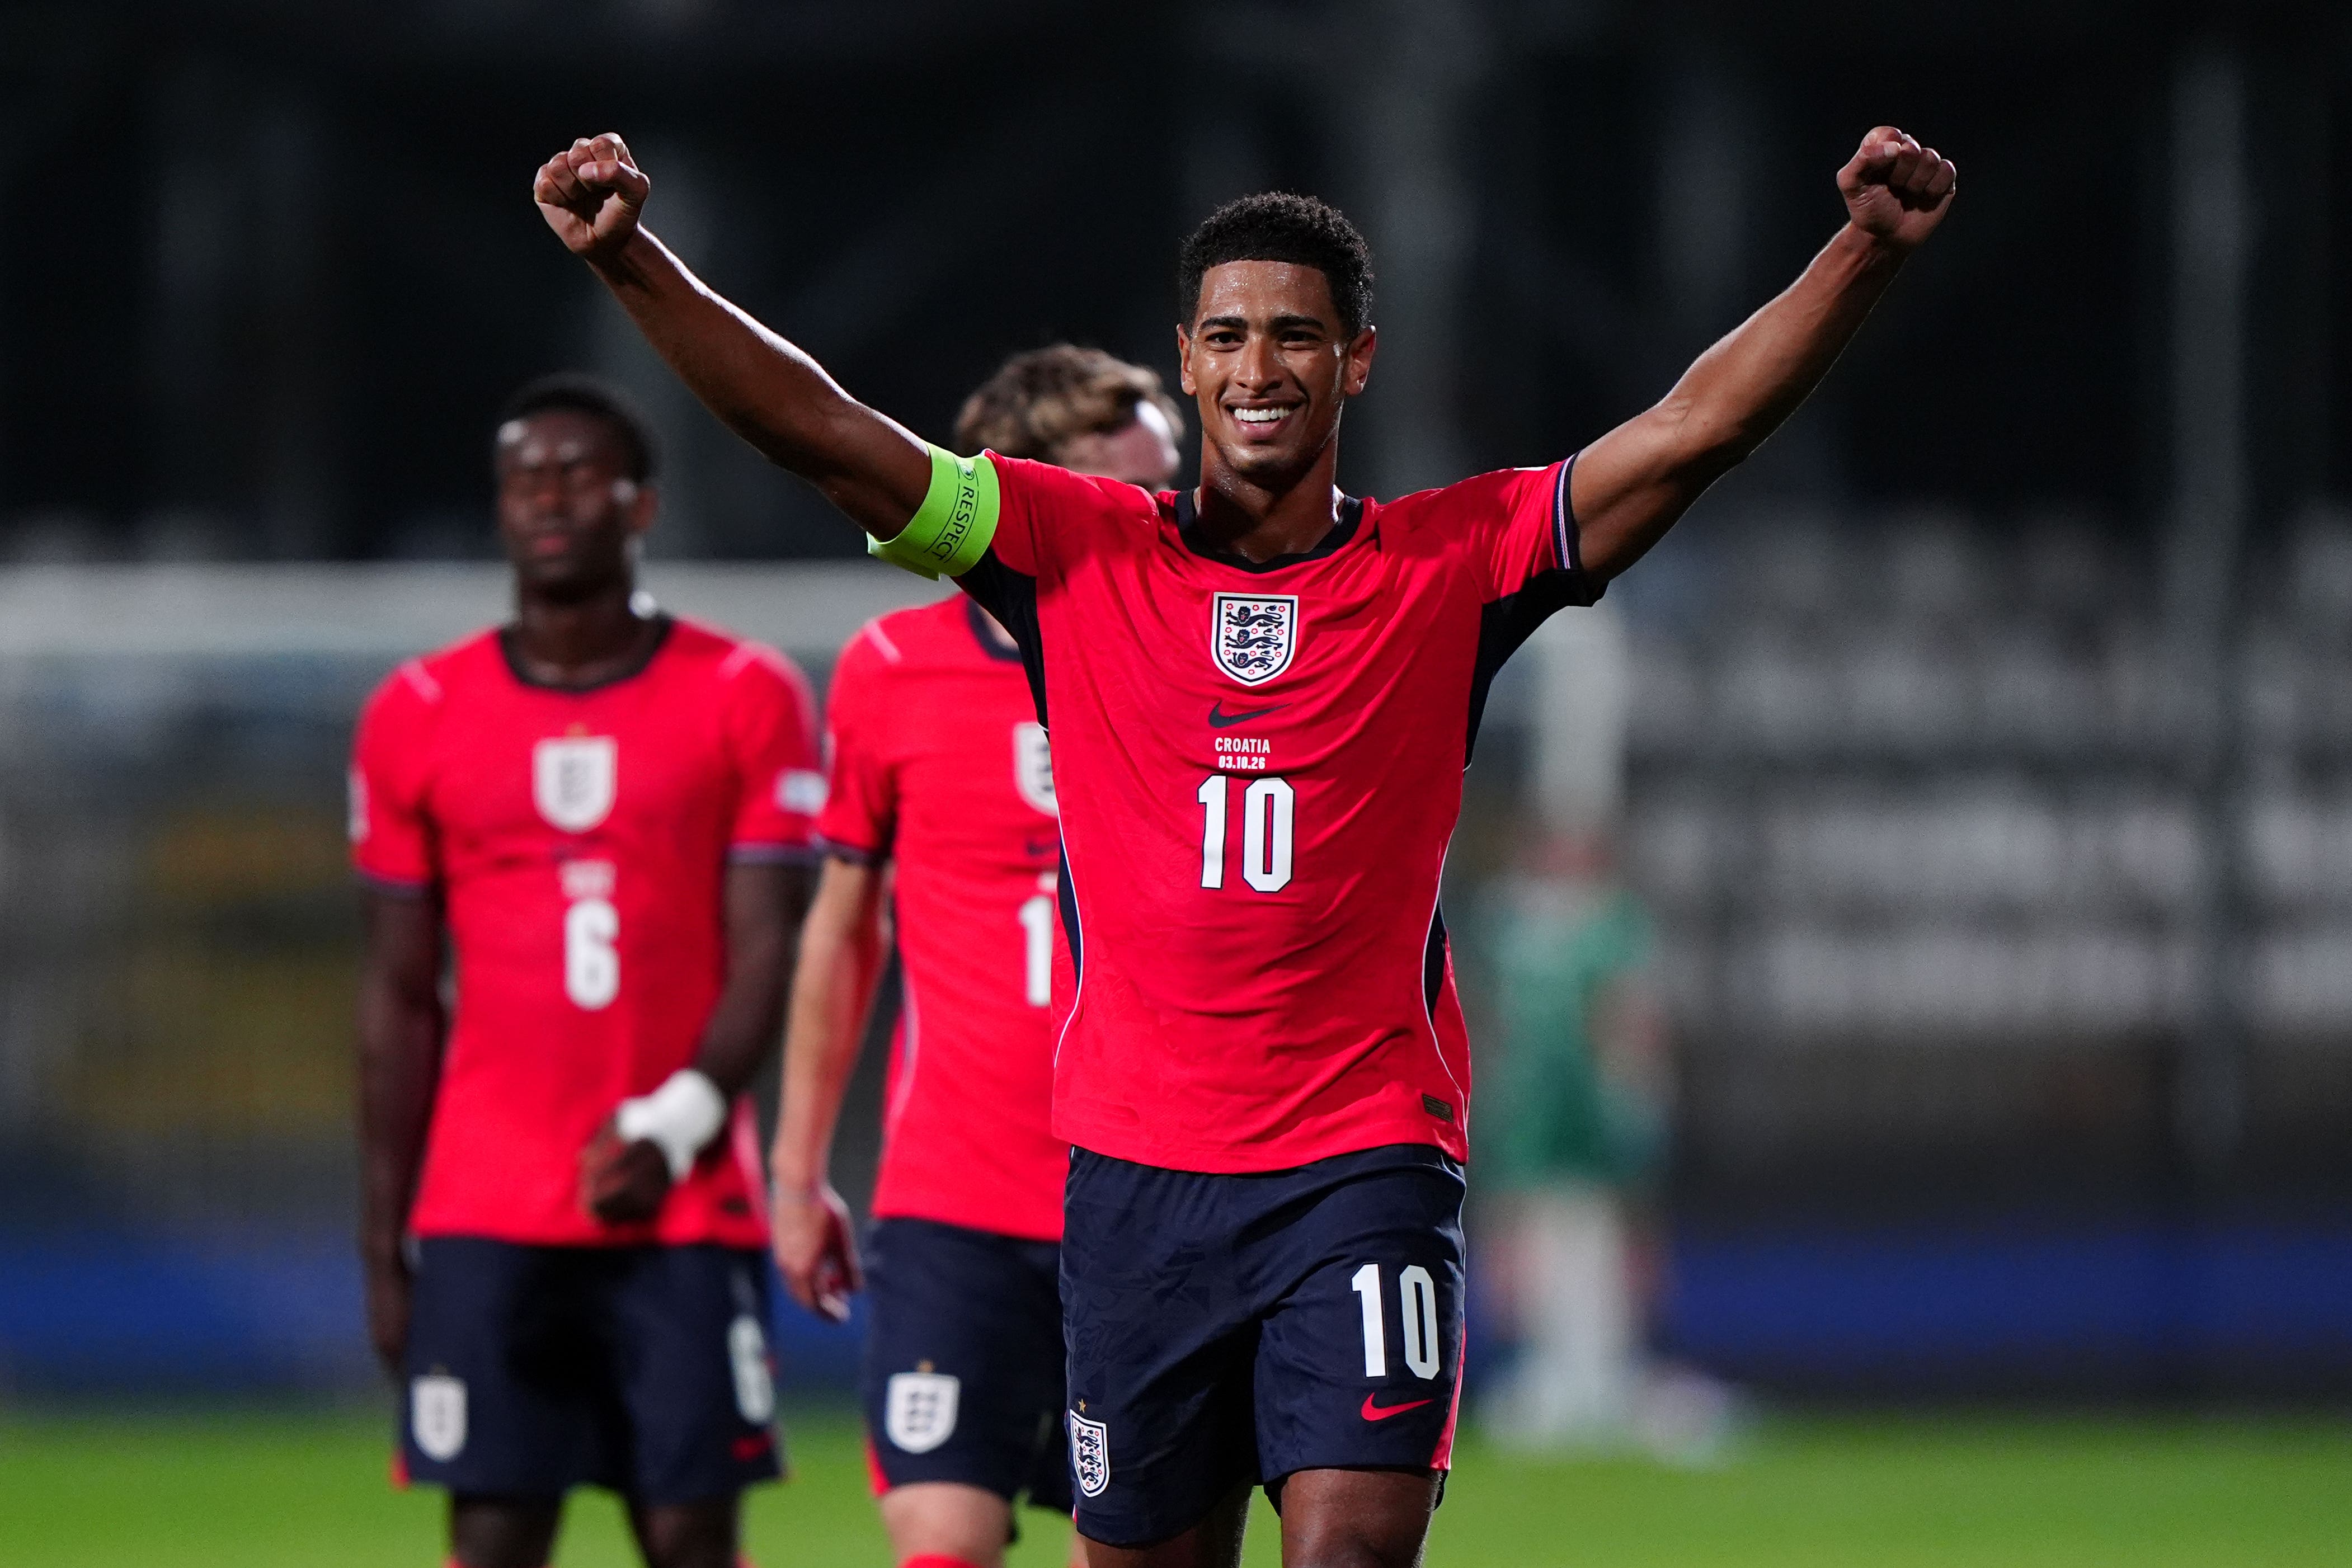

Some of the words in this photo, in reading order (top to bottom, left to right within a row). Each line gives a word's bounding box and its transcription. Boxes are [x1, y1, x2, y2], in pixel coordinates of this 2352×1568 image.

[932, 486, 974, 561] RESPECT
[1215, 737, 1271, 754] CROATIA
[1219, 755, 1266, 770] 03.10.26
[1197, 774, 1295, 893] 10
[564, 897, 620, 1011] 6
[1351, 1263, 1441, 1381] 10
